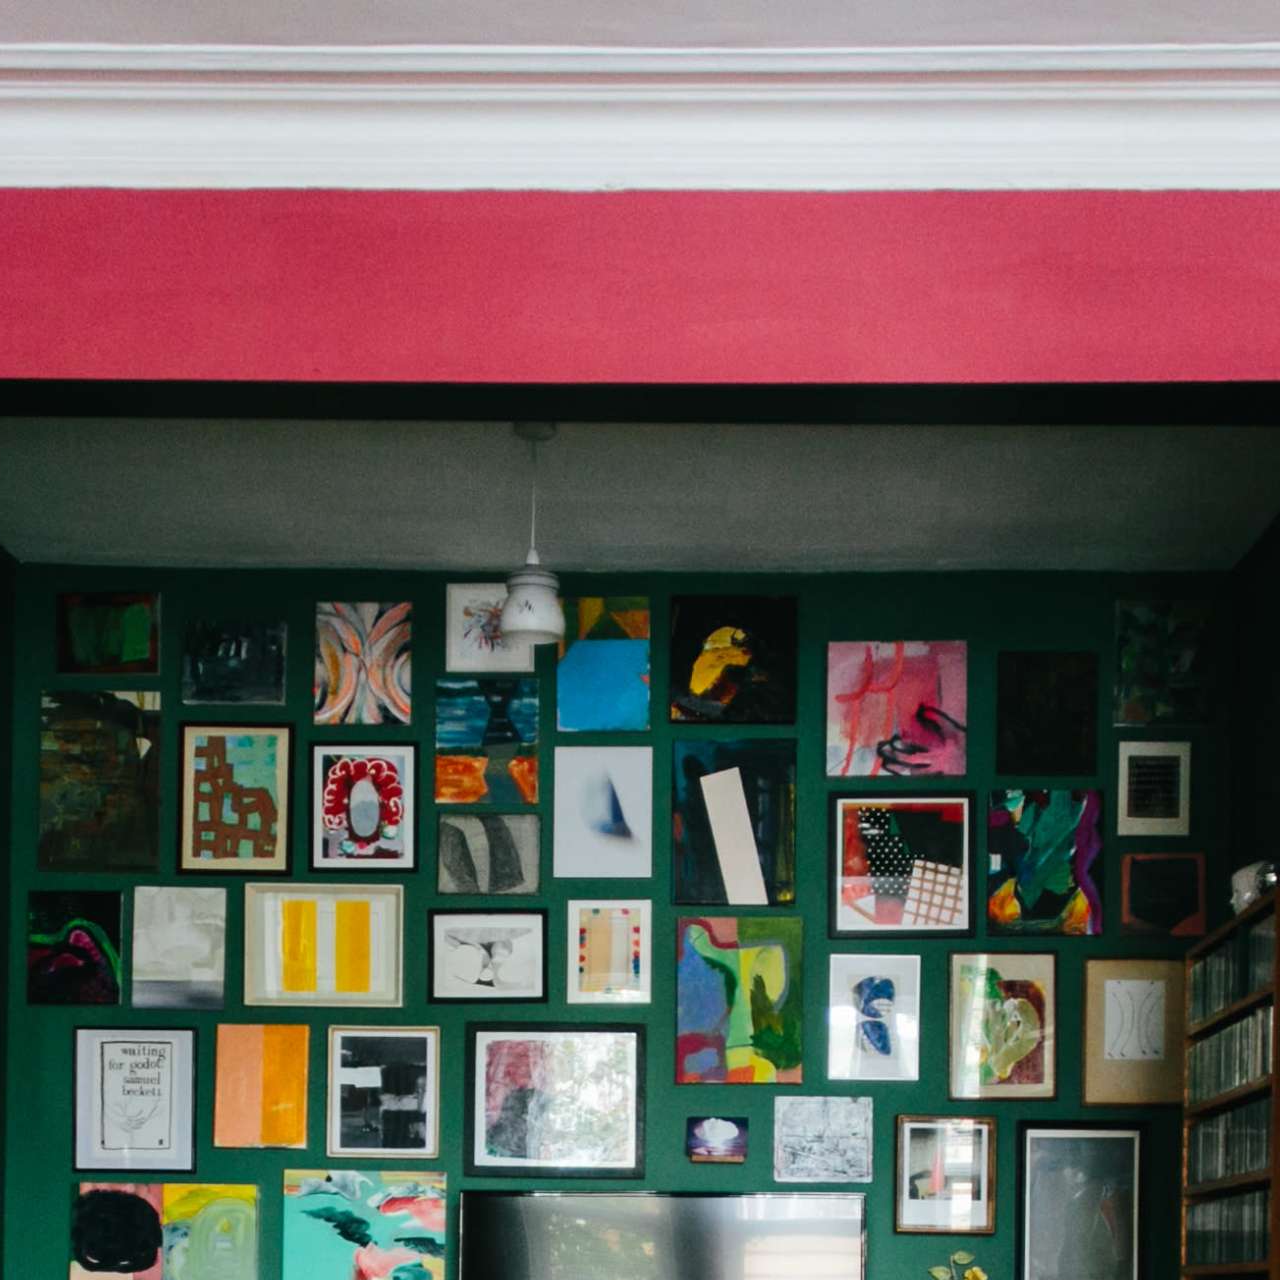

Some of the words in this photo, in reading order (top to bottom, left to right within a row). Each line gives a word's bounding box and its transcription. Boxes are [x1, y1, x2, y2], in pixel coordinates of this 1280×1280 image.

[121, 1045, 166, 1060] waiting
[109, 1059, 124, 1071] for
[123, 1071, 161, 1085] samuel
[122, 1085, 162, 1097] beckett
